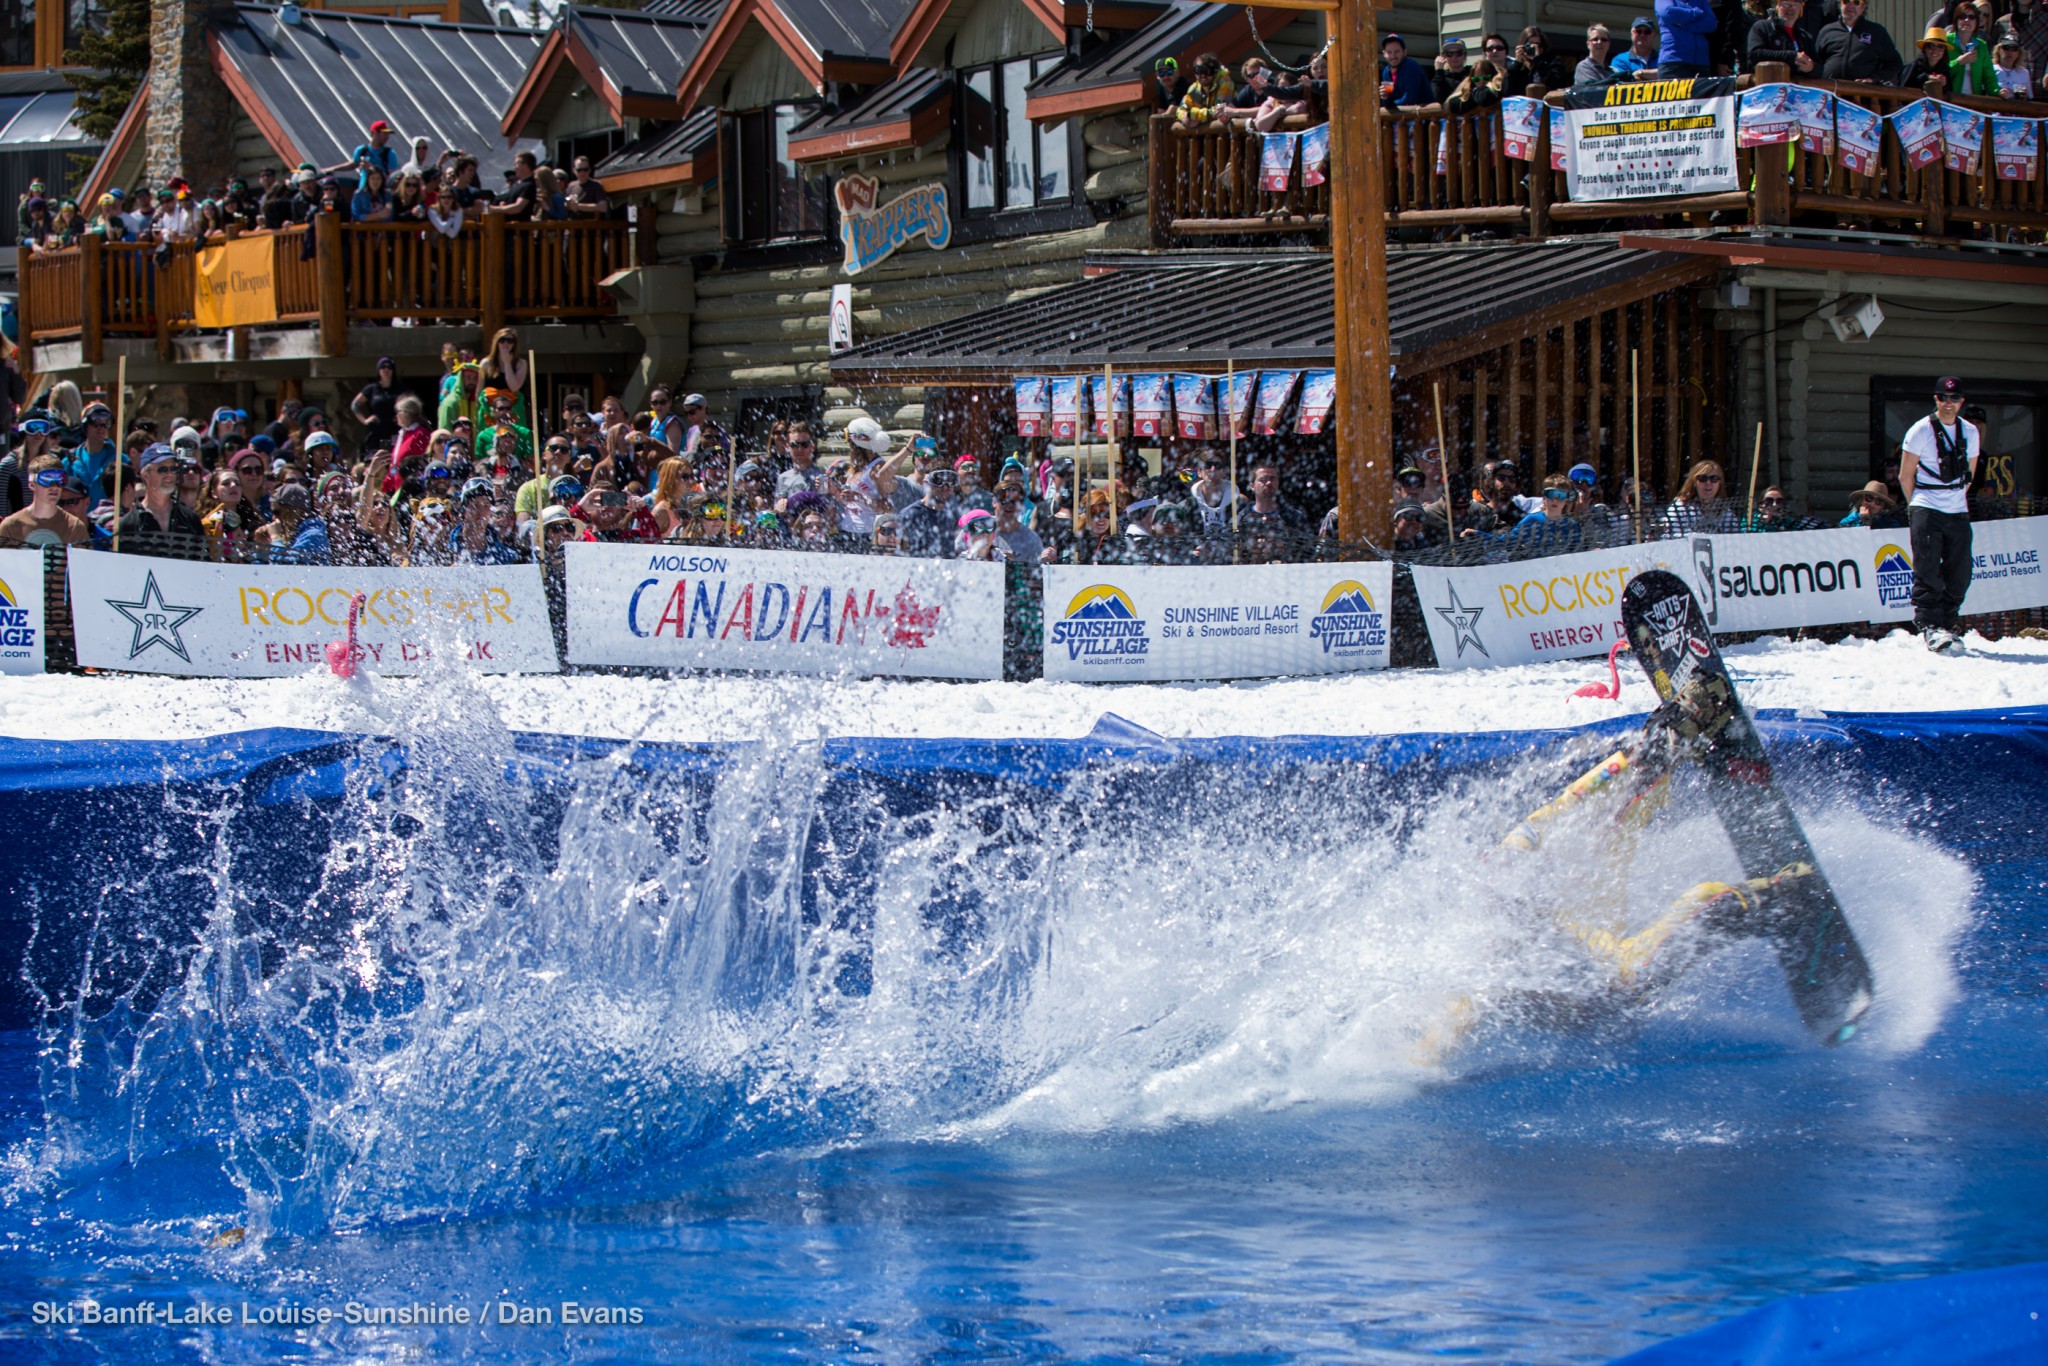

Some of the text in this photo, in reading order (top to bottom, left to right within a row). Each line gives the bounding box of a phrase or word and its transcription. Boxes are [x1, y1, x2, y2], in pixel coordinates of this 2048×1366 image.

[1603, 78, 1696, 107] ATTENTION!
[1595, 103, 1701, 121] Due to the high risk of injury
[1583, 115, 1715, 137] SNOWBALL THROWING IS PROHIBITED.
[1579, 139, 1600, 151] Anyone
[1603, 137, 1626, 149] caught
[1629, 135, 1647, 147] doing
[1650, 136, 1659, 144] so
[1662, 132, 1674, 143] will
[1678, 131, 1687, 142] be
[1689, 128, 1725, 141] escorted
[1595, 145, 1703, 163] off the mountain immediately.
[1577, 165, 1729, 185] Please help us to have a safe and fun day
[851, 183, 870, 201] MAD
[1616, 182, 1686, 197] at Sunshine Village.
[842, 186, 944, 265] TRAPPERS
[649, 555, 727, 573] MOLSON
[1990, 550, 2039, 566] VILLAGE
[1719, 559, 1862, 599] salomon
[1877, 572, 1915, 588] UNSHIN
[1971, 563, 2042, 582] owboard Resort
[1499, 566, 1631, 619] ROCKST
[1878, 585, 1914, 606] VILLA
[628, 577, 875, 646] CANADIAN
[1164, 604, 1299, 625] SUNSHINE VILLAGE
[1652, 594, 1681, 621] ARTS
[1051, 619, 1146, 644] SUNSHINE
[1163, 621, 1299, 639] Ski & Snowboard Resort
[1309, 613, 1383, 639] SUNSHINE
[1321, 629, 1387, 654] VILLAGE
[1530, 623, 1604, 651] ENERGY
[265, 642, 384, 663] ENEGY
[1067, 637, 1150, 661] VILLAGE
[1333, 648, 1383, 658] skibanff.com
[1083, 657, 1145, 667] skibanff.com
